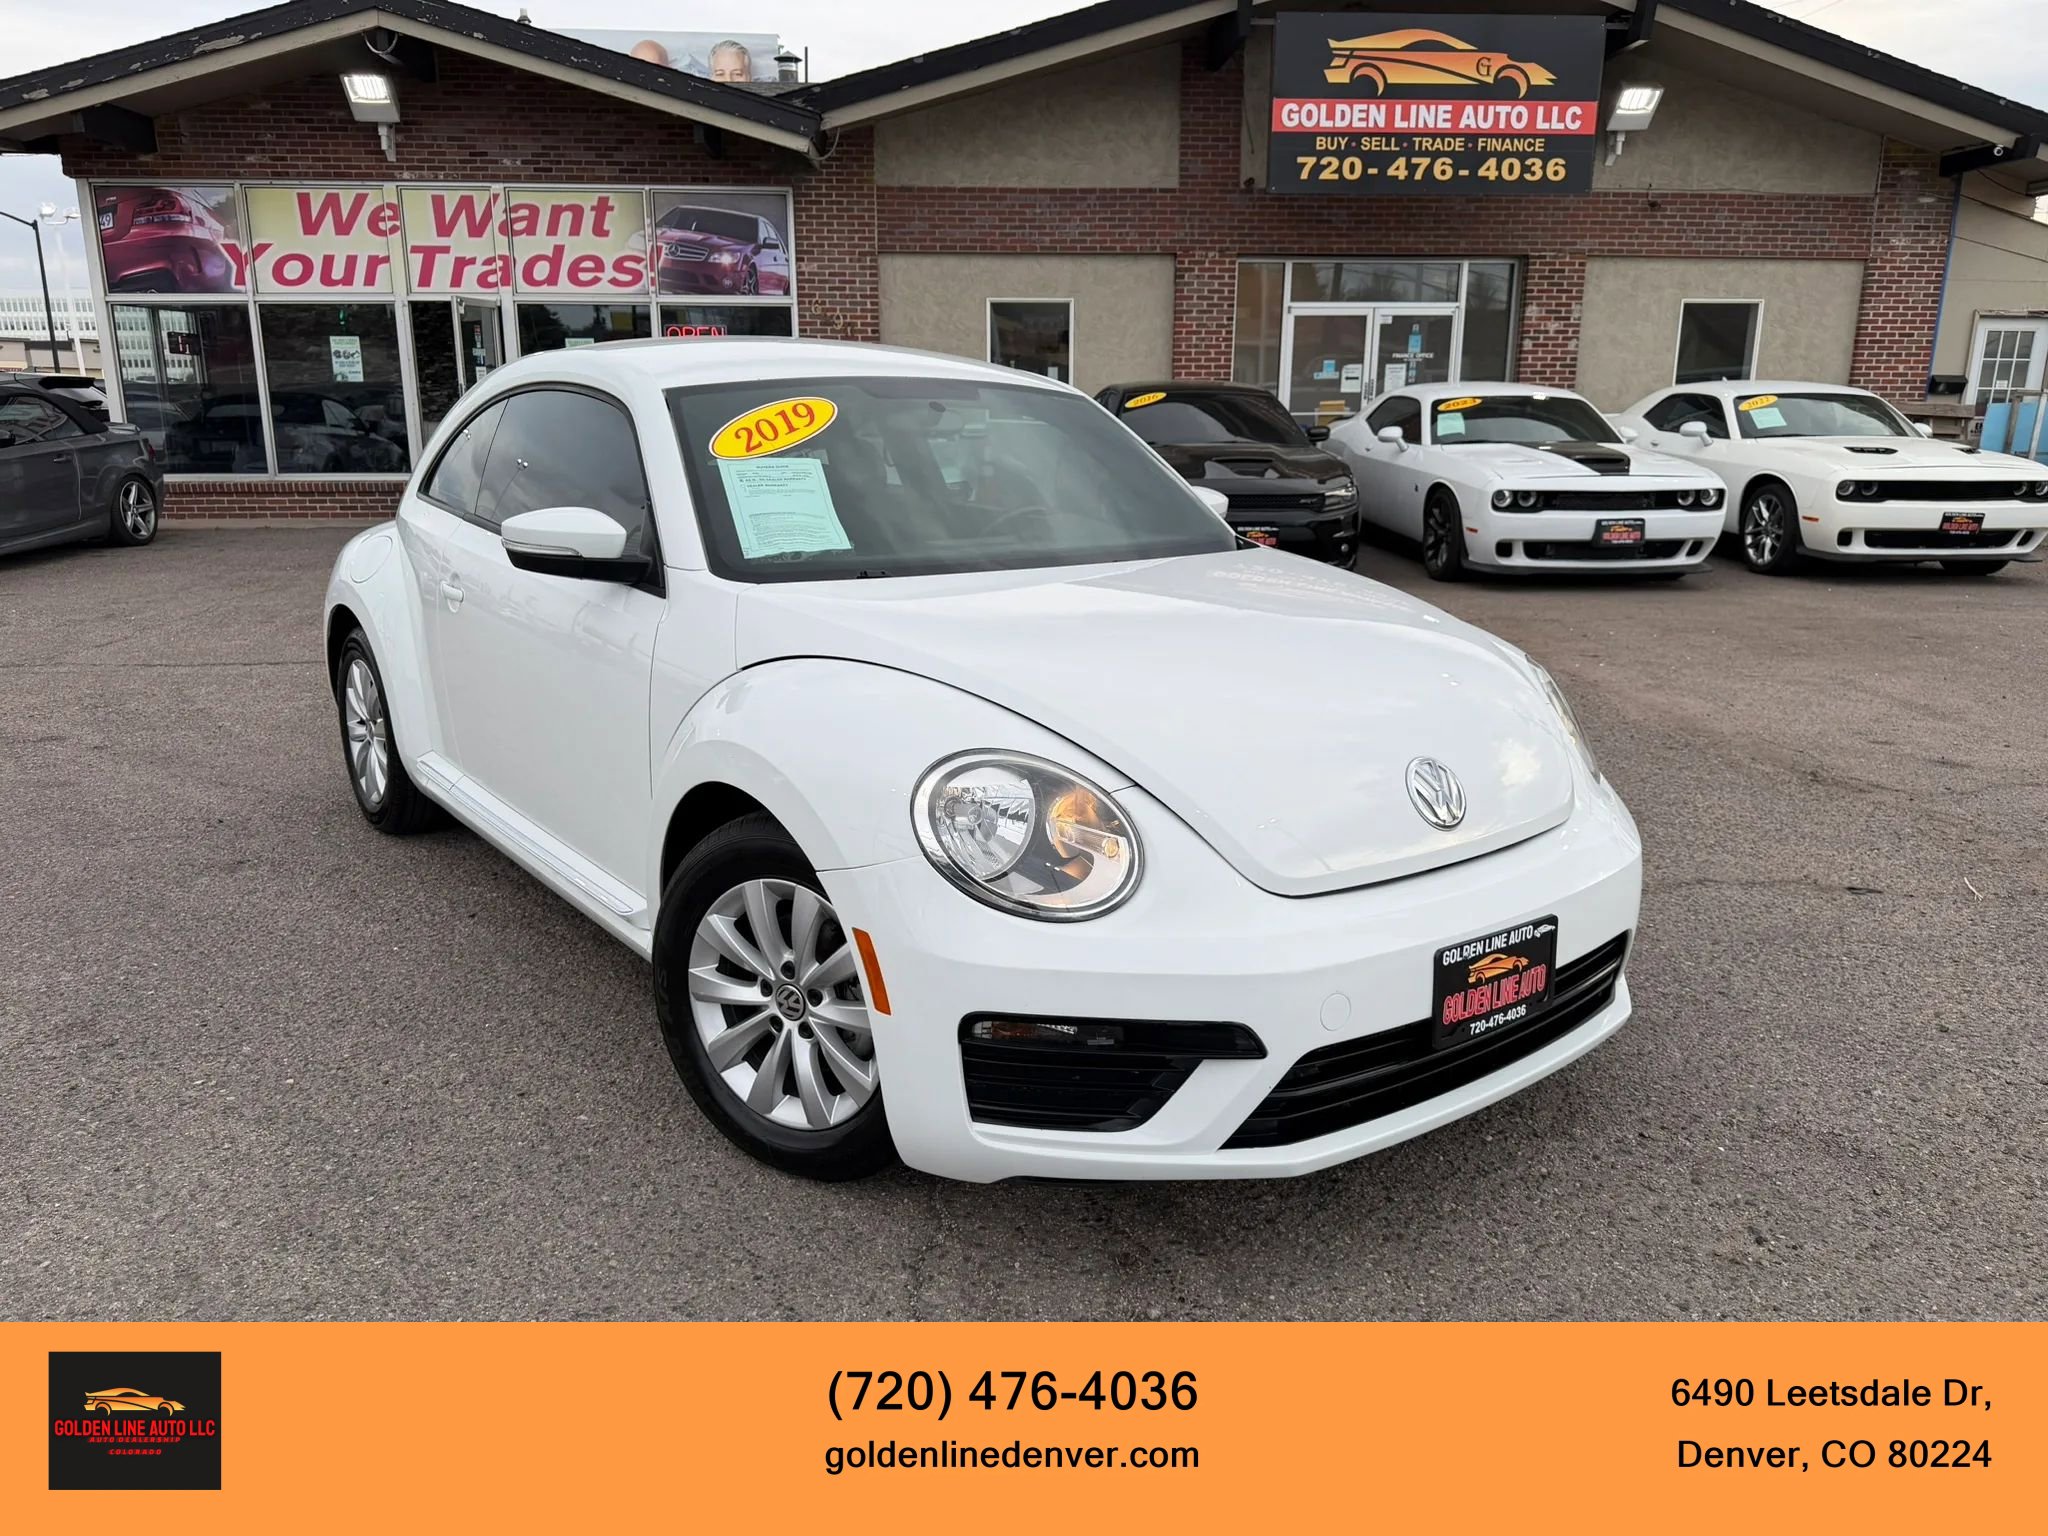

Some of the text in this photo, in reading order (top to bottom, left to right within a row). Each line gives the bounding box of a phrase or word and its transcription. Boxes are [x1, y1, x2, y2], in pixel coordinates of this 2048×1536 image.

[1476, 56, 1492, 77] G
[1281, 103, 1582, 130] GOLDEN LINE AUTO LLC
[1315, 136, 1545, 152] BUY SELL TRADE FINANCE
[1296, 156, 1567, 182] 720-476-4036
[296, 192, 614, 238] We Want
[221, 243, 663, 288] Your Trades!
[734, 403, 815, 453] 2019
[1442, 924, 1534, 966] GOLDEN LINE AUTO
[1443, 963, 1547, 1025] GOLDEN LINE AUTO
[1469, 1004, 1527, 1035] 720-476-4036
